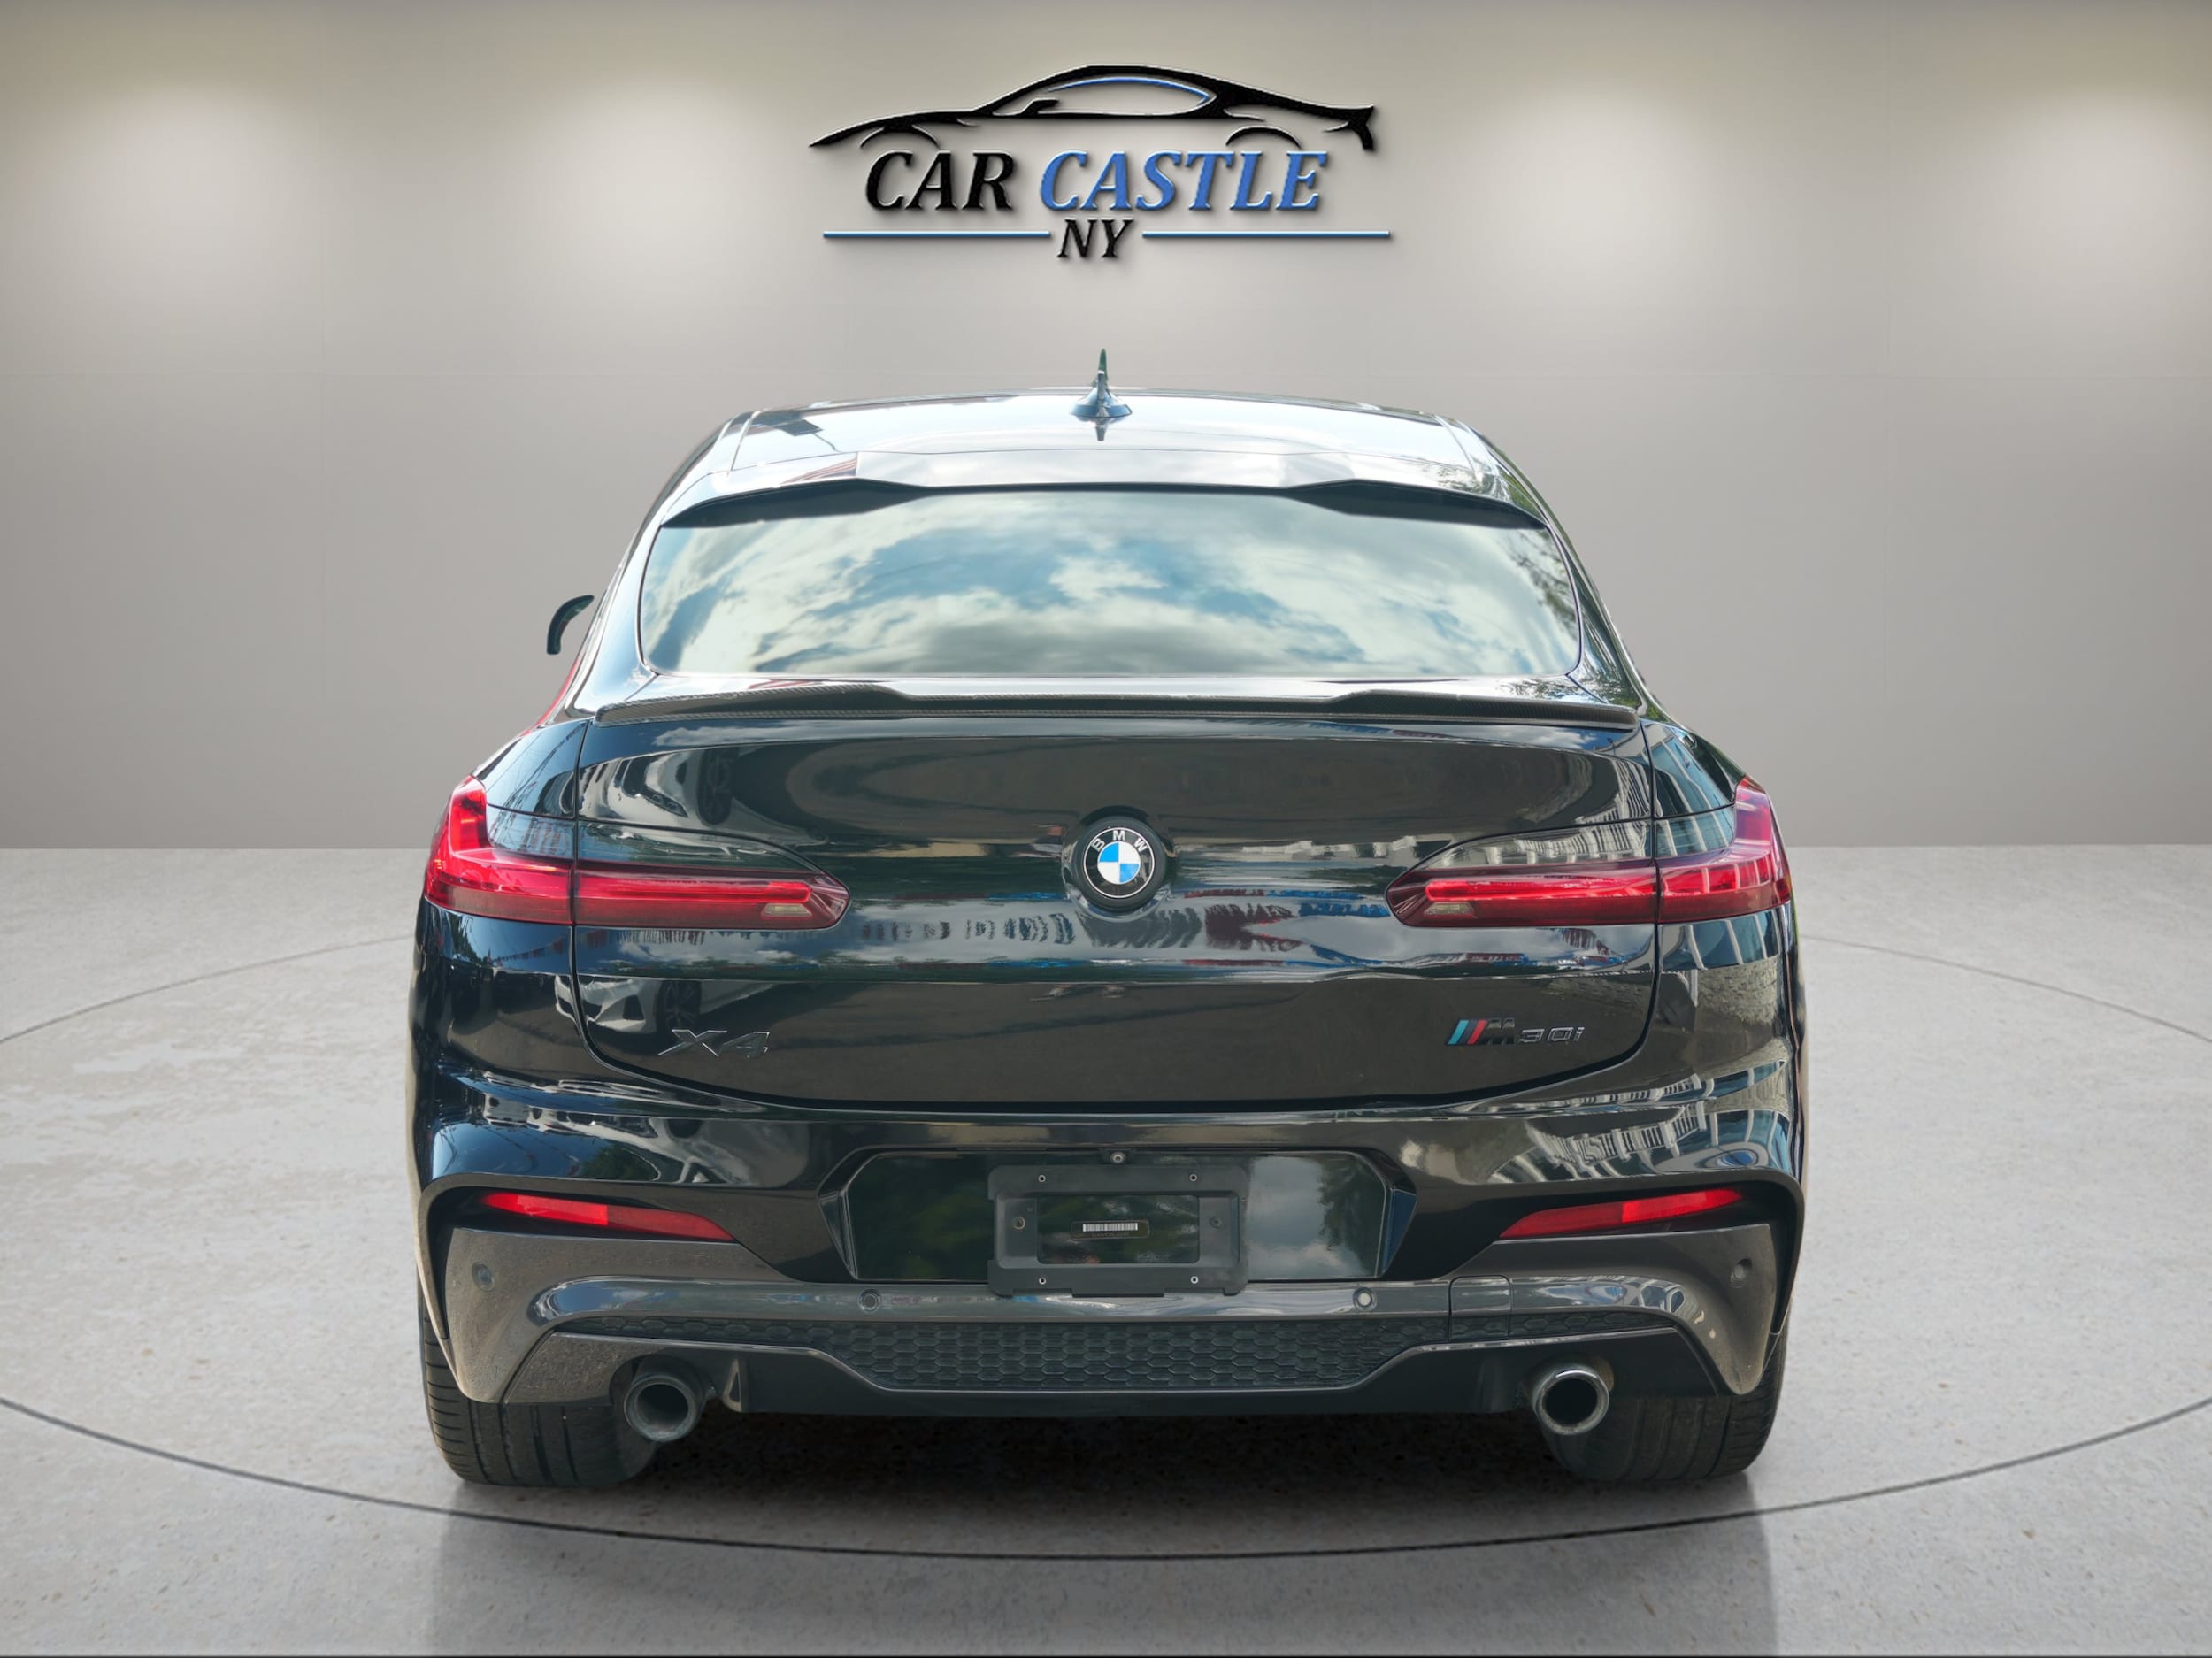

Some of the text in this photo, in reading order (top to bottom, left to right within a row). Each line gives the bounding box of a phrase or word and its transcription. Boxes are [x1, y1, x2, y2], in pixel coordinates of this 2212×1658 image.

[866, 150, 1328, 211] CAR CASTLE
[1057, 219, 1133, 258] NY
[1091, 830, 1148, 852] BMW
[657, 1029, 770, 1058] X4
